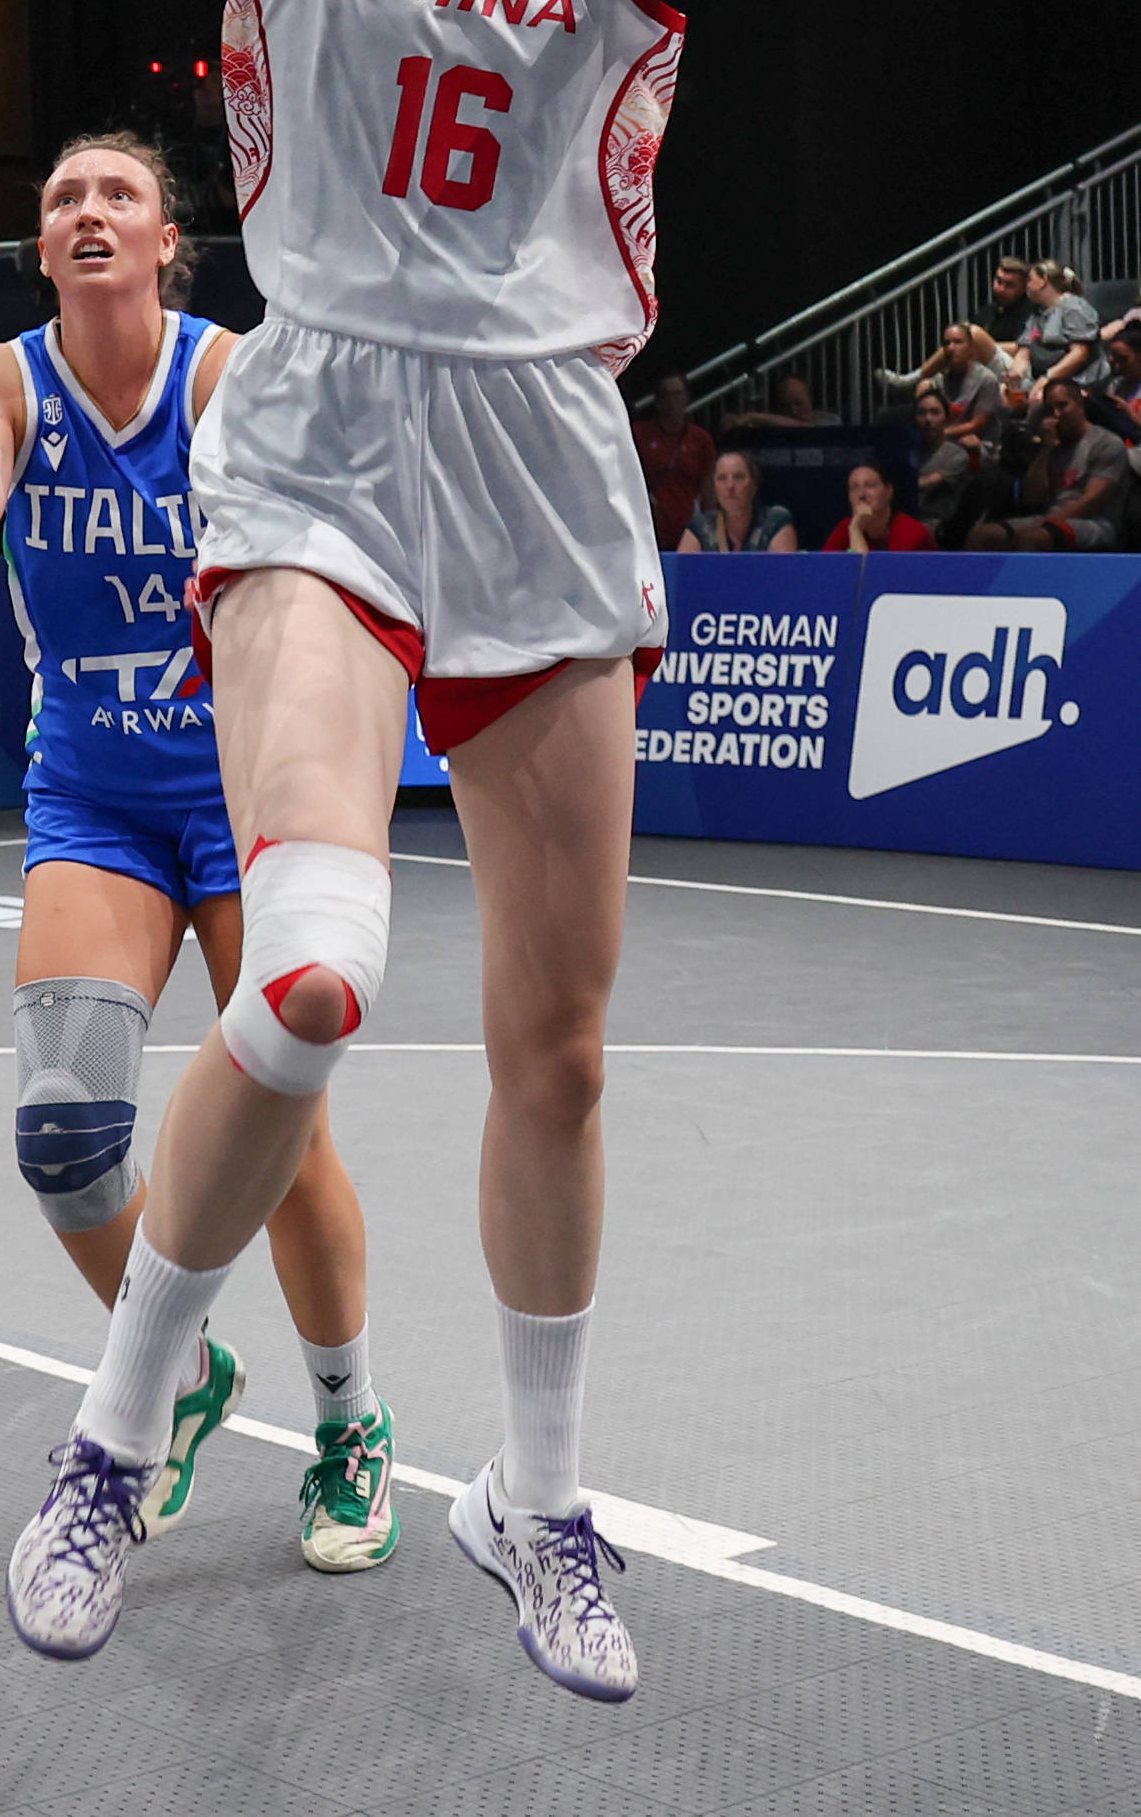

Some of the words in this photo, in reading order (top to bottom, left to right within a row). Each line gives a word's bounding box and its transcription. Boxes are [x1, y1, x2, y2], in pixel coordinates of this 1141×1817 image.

[381, 55, 514, 212] 16
[103, 573, 181, 624] 14
[691, 612, 839, 648] GERMAN
[652, 651, 836, 688] NIVERSITY
[687, 690, 830, 730] SPORTS
[634, 729, 825, 770] EDERATION
